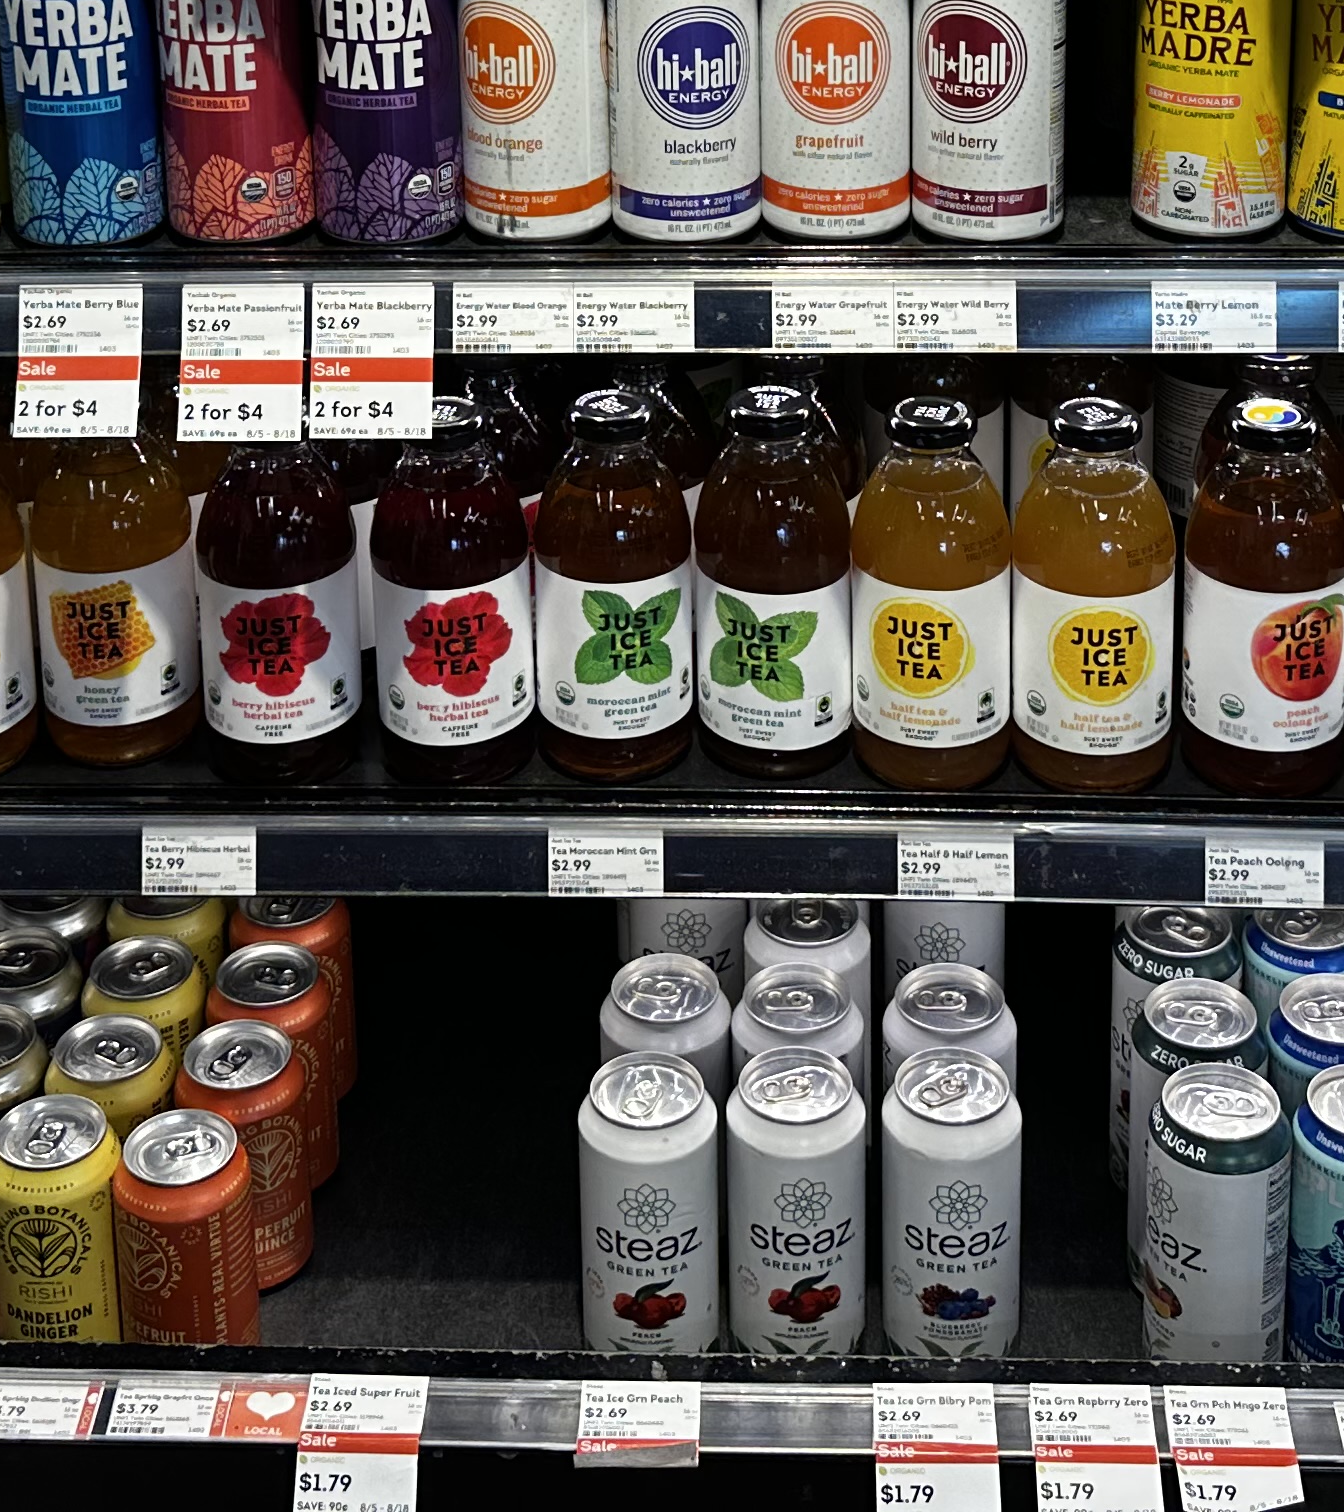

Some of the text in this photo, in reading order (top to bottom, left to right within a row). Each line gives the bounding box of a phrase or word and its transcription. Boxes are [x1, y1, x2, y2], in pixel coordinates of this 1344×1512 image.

[13, 41, 128, 97] MATE
[656, 42, 737, 90] hi ball
[668, 88, 730, 105] ENERGY
[664, 136, 737, 156] blackberry
[795, 132, 864, 152] grapefruit
[23, 299, 139, 310] Yerba Mate Berry Blue
[23, 315, 67, 329] $2.69
[19, 361, 56, 377] Sale
[18, 400, 98, 419] 2 for $4
[887, 616, 953, 641] JUST
[898, 641, 941, 660] ICE
[896, 660, 943, 680] TEA
[587, 687, 672, 708] moroccan mint
[603, 702, 657, 718] green tea
[596, 1225, 703, 1262] steaz
[607, 1260, 689, 1278] GREEN TEA
[6, 1305, 92, 1324] DANDELION
[19, 1322, 79, 1339] GINGER
[310, 1401, 351, 1413] $2.69
[299, 1472, 351, 1493] $1.79
